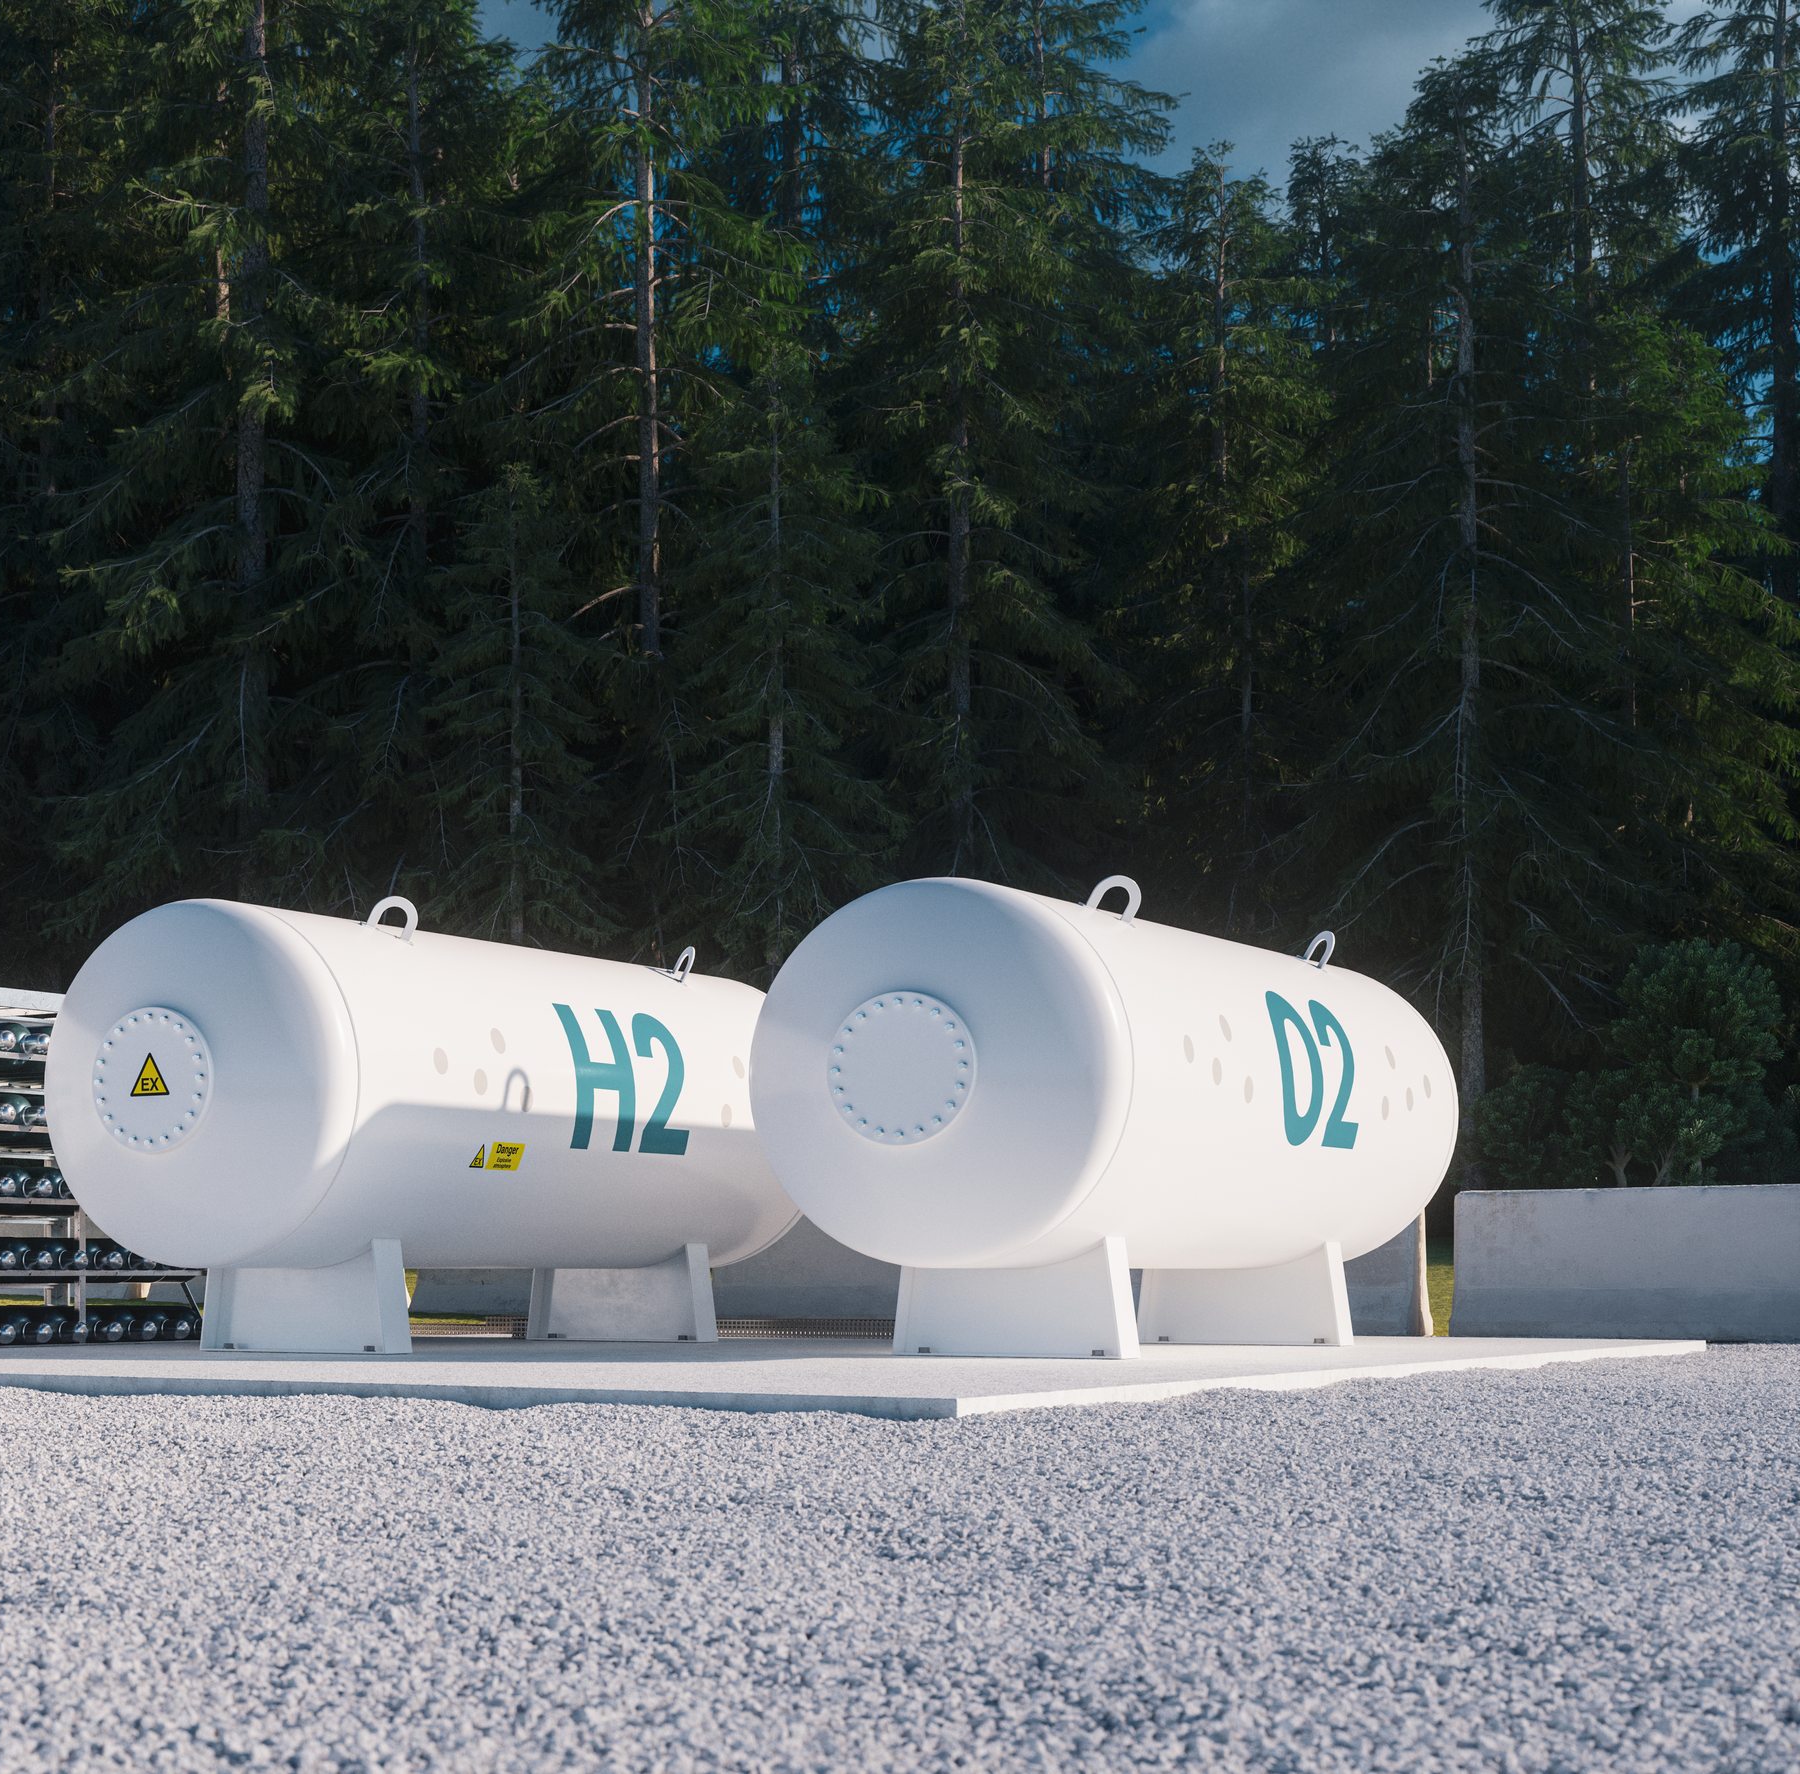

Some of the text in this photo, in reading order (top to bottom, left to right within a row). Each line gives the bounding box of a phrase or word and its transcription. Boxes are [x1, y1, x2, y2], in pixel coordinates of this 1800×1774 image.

[1265, 990, 1359, 1149] O2
[141, 1077, 159, 1092] EX
[552, 1003, 690, 1156] H2
[496, 1143, 520, 1157] Danger
[473, 1157, 483, 1166] EX
